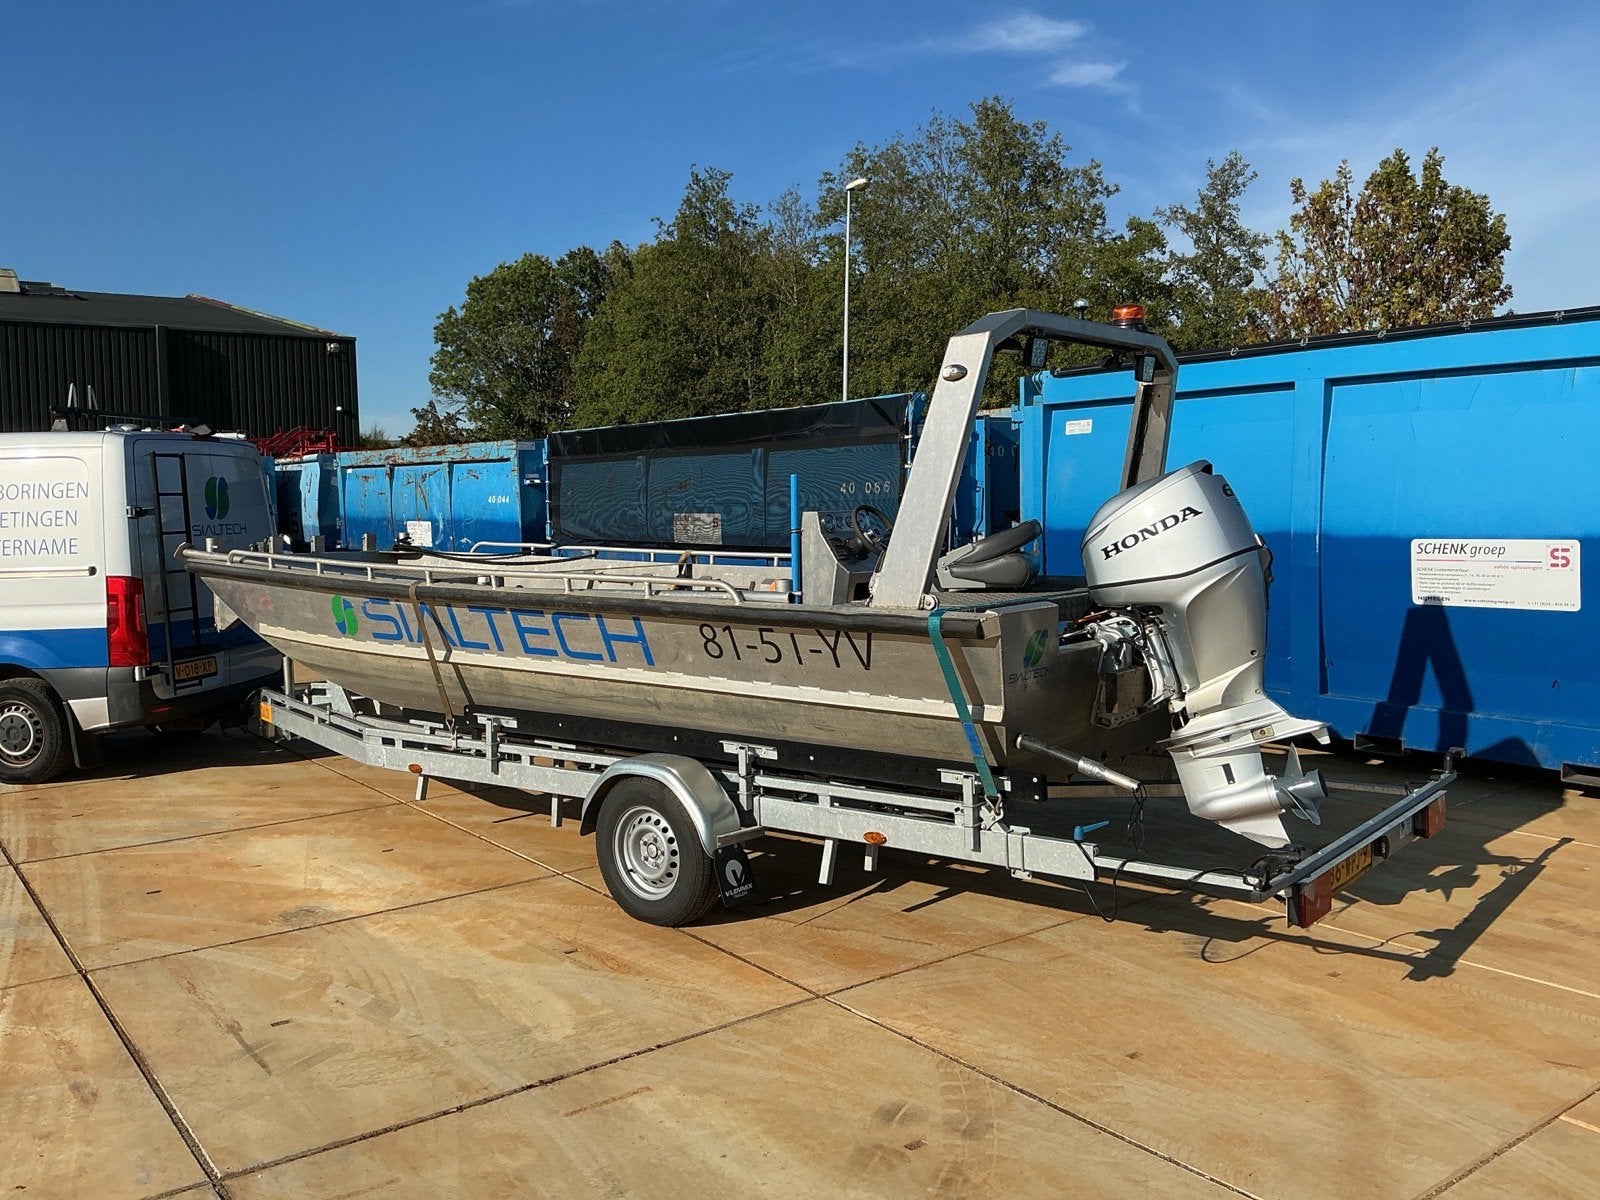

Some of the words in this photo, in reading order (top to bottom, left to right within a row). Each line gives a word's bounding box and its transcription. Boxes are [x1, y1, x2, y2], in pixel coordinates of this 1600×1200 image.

[840, 481, 856, 495] 40
[488, 495, 496, 503] 40
[497, 495, 510, 503] 044
[192, 523, 248, 537] SIALTECH
[1100, 505, 1203, 560] HONDA
[0, 538, 78, 556] ERNAME
[1417, 543, 1469, 555] SCHENK
[1470, 546, 1506, 558] groep
[361, 598, 656, 667] SIALTECH
